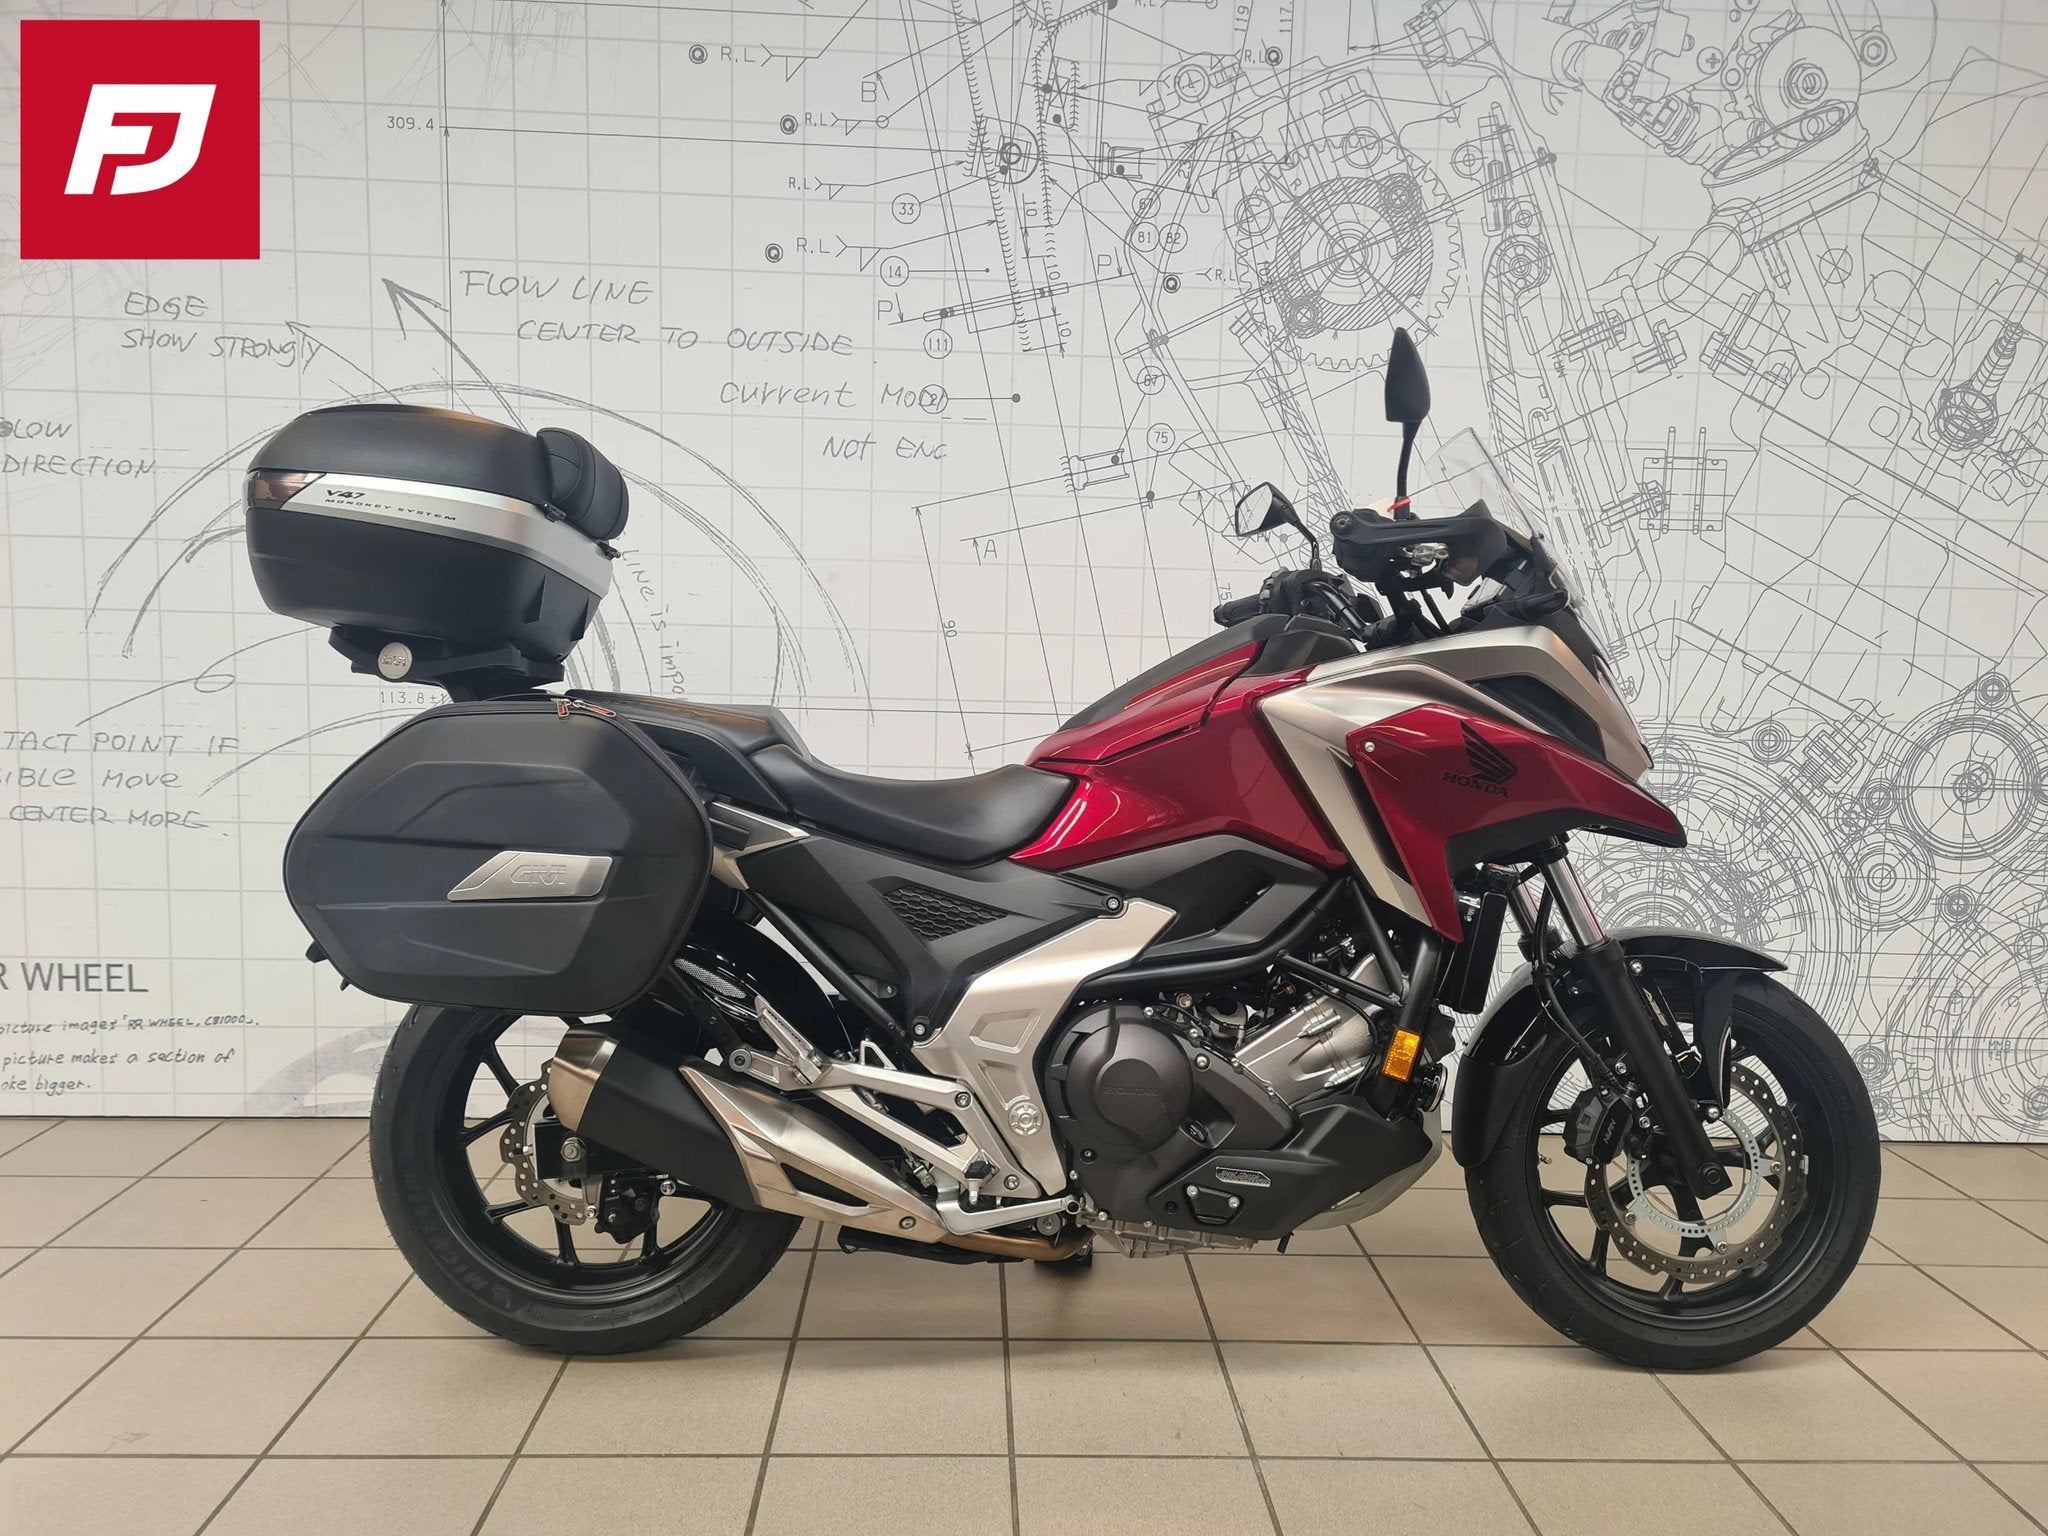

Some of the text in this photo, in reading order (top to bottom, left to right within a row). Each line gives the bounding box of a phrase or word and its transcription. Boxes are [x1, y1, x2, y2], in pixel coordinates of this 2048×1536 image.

[861, 81, 876, 102] B
[386, 115, 434, 131] 309.4
[898, 203, 914, 216] 33
[1137, 231, 1151, 244] 81
[1165, 230, 1181, 244] 82
[1097, 254, 1112, 275] P
[460, 269, 653, 304] FLOW LINE
[124, 291, 209, 320] EDGE
[877, 300, 893, 320] P
[121, 328, 197, 352] SHOW
[517, 320, 853, 355] CENTER TO OUTSIDE
[1154, 431, 1168, 444] 75
[1, 453, 156, 479] DIRECTION
[326, 489, 366, 500] V47
[397, 506, 457, 522] SYSTEM
[983, 539, 998, 559] A
[943, 620, 958, 638] 90
[93, 732, 184, 757] POINT
[208, 735, 240, 757] IF
[1441, 770, 1509, 799] HONDA
[9, 804, 115, 826] CENTER
[20, 962, 149, 993] WHEEL
[3, 1047, 235, 1073] picture makes a section of
